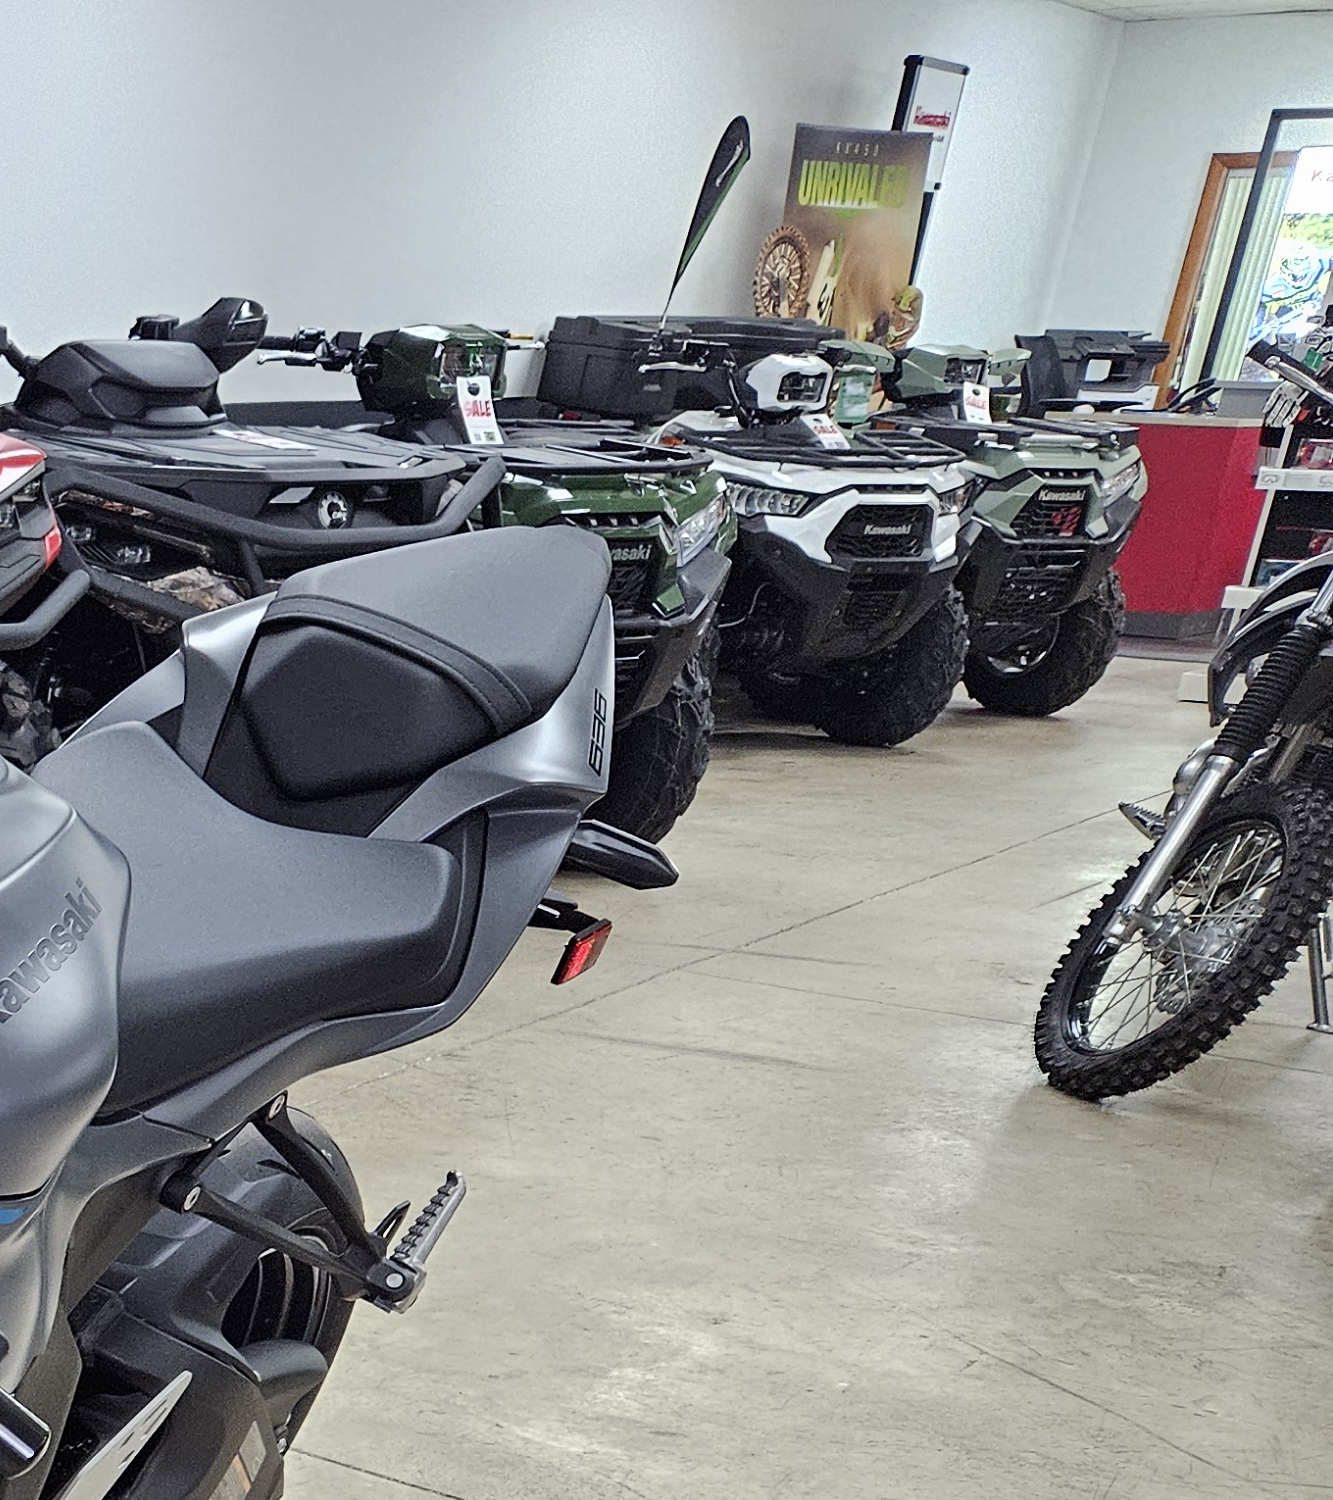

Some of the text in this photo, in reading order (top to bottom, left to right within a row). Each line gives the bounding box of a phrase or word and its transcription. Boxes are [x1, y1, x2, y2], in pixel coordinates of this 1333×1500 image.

[464, 400, 492, 417] SALE
[1038, 489, 1086, 501] Kawasaki
[611, 544, 652, 560] asaki
[588, 687, 607, 777] 636
